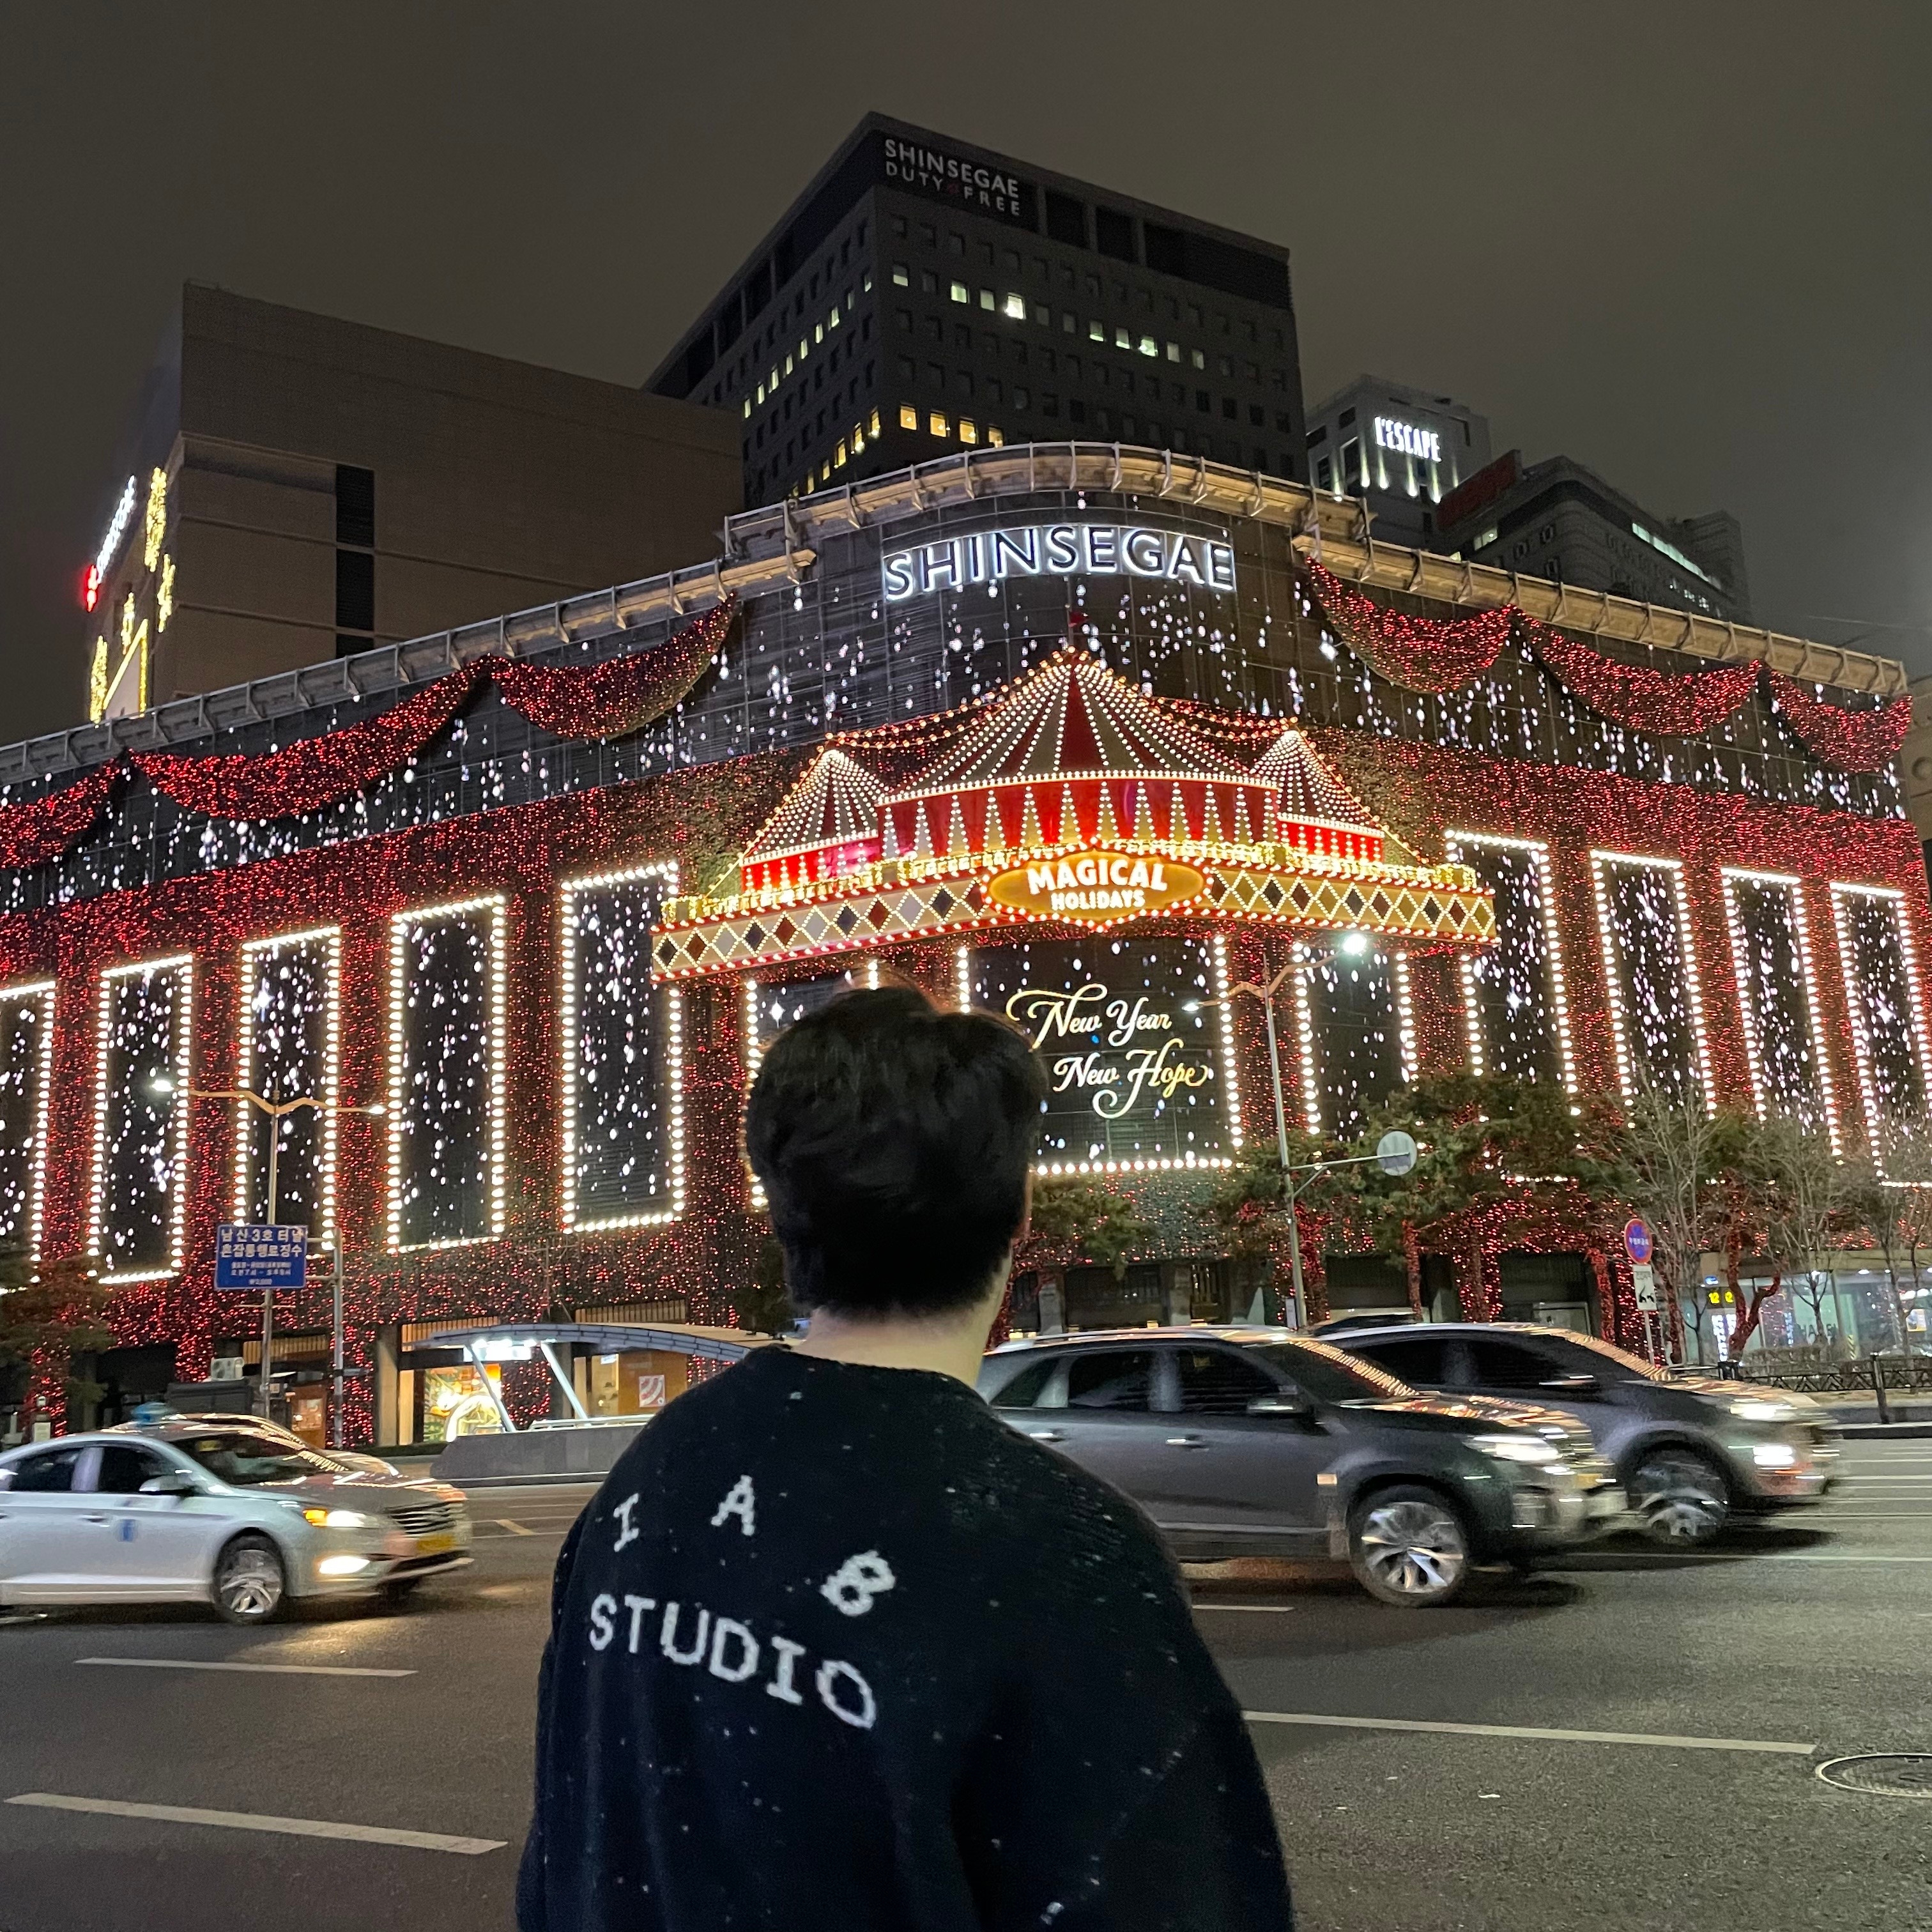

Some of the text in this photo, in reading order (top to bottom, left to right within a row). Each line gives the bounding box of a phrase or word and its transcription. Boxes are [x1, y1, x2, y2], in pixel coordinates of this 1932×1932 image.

[885, 139, 1019, 199] SHINSEGAE
[886, 161, 1020, 216] DUTY FREE
[885, 525, 1234, 601] SHINSEGAE
[1026, 858, 1168, 894] MAGICAL
[1051, 889, 1146, 911] HOLIDAYS
[1006, 983, 1172, 1052] New Year
[1052, 1038, 1208, 1119] New Hope
[589, 1593, 877, 1728] STUDIO
